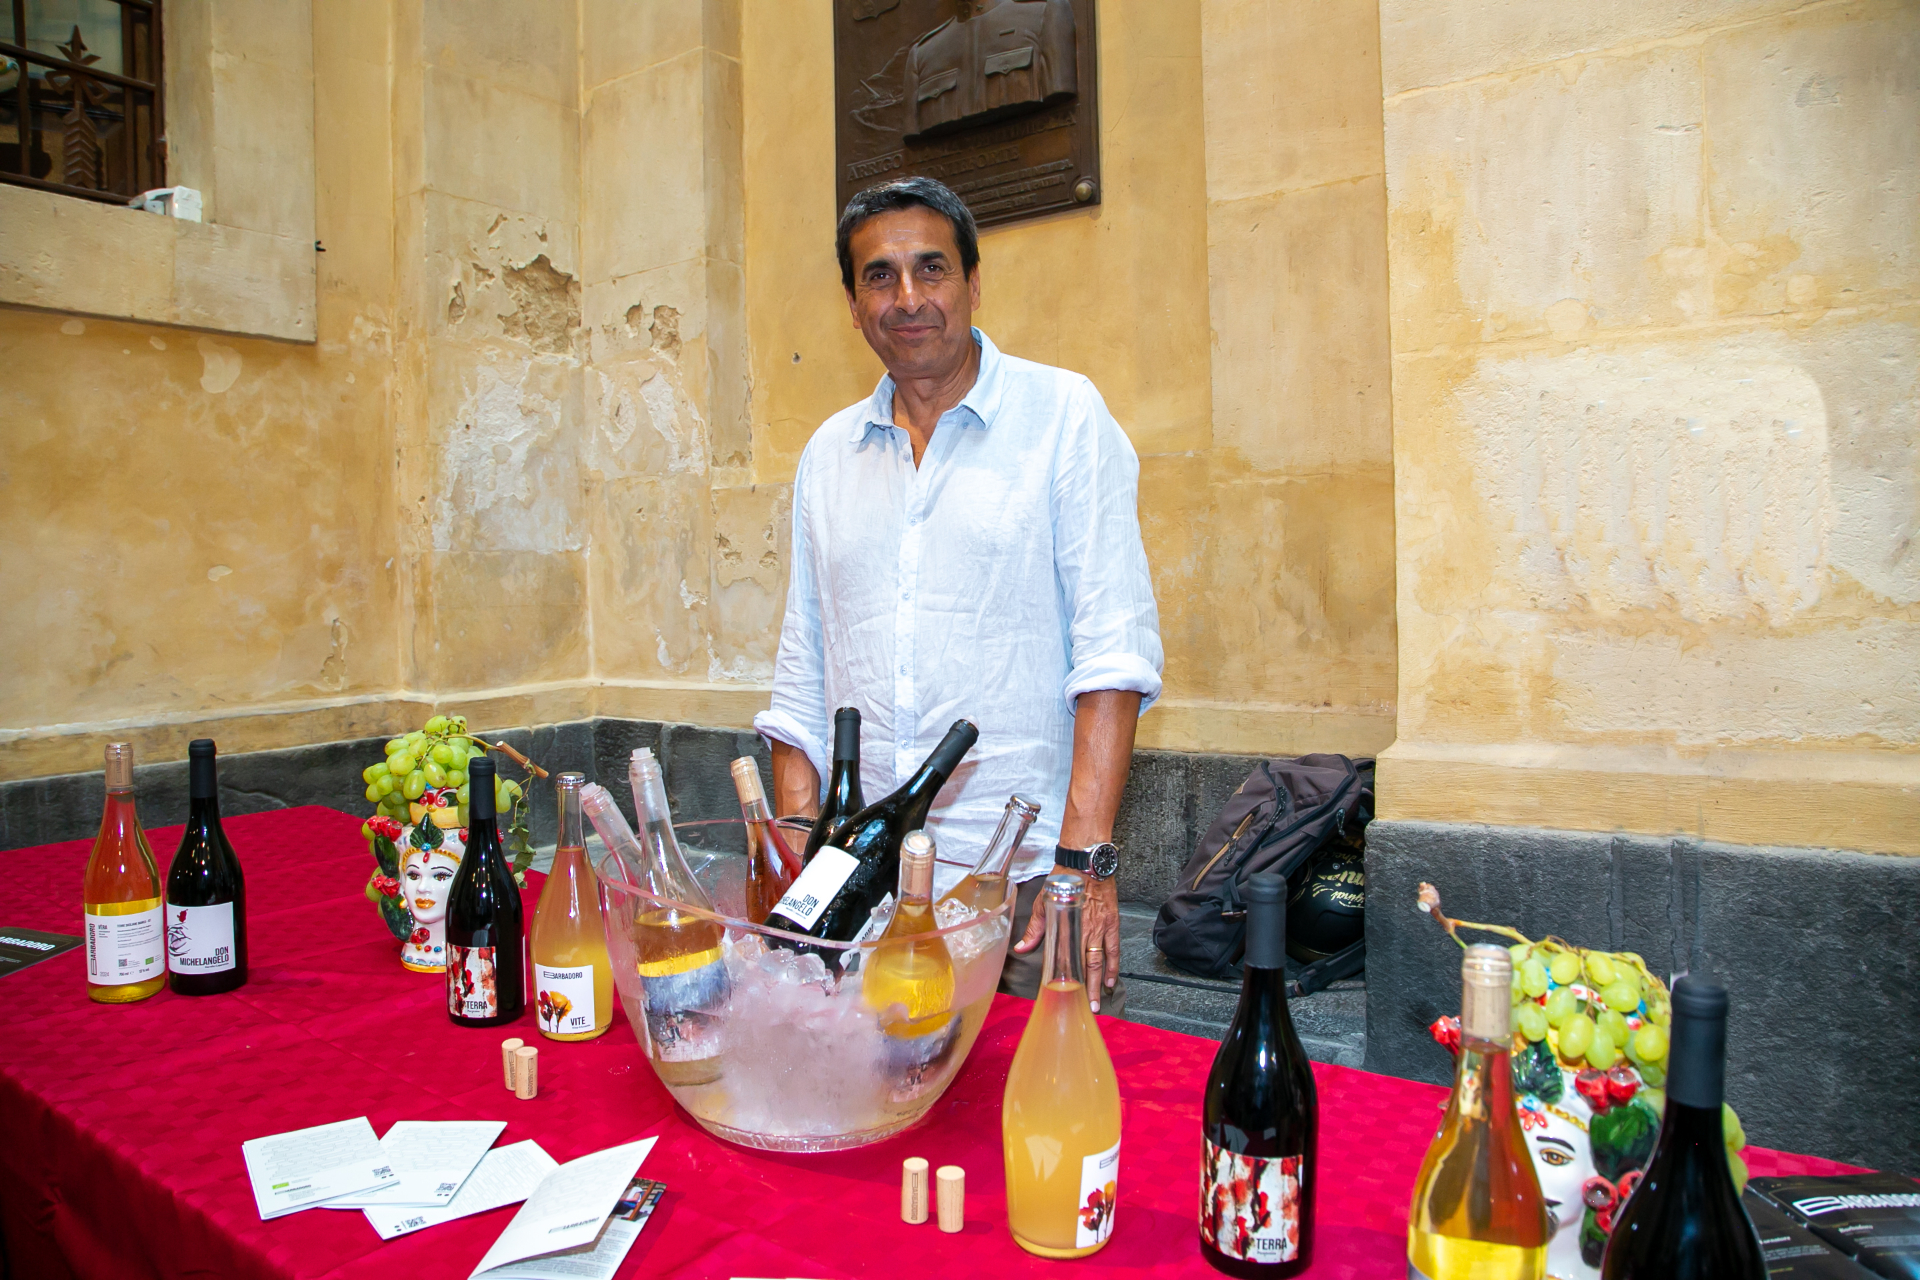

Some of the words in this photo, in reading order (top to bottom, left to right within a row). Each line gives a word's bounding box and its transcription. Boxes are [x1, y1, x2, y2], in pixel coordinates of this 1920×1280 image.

[848, 153, 903, 182] ARRIGO
[802, 894, 820, 908] DON
[0, 936, 56, 951] ARBADORO
[214, 946, 229, 957] DON
[179, 954, 230, 967] MICHELANGELO
[543, 971, 583, 980] BARBADORO
[466, 1000, 488, 1010] TERRA
[570, 1016, 586, 1026] VITE
[1256, 1237, 1288, 1250] TERRA
